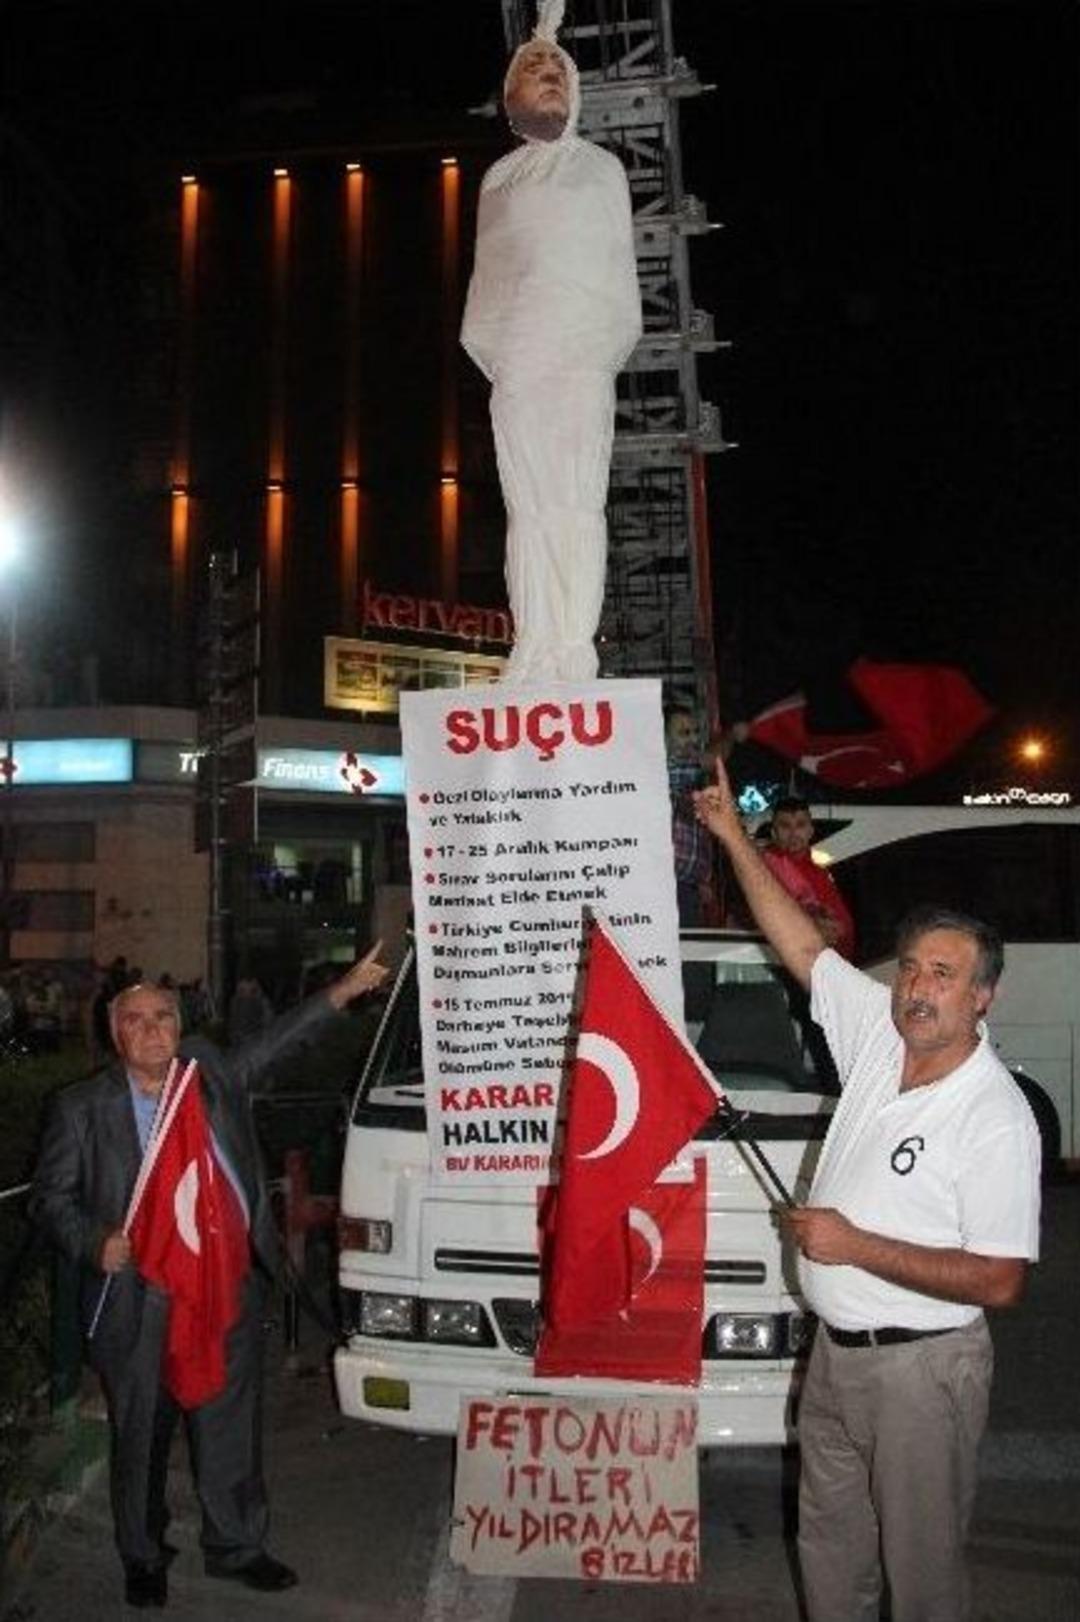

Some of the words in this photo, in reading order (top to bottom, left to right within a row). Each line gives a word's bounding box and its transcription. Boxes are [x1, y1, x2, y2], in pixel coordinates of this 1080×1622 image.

[446, 701, 613, 762] SUÇU
[263, 757, 329, 780] Finans
[429, 816, 448, 827] ve
[464, 996, 532, 1011] Temmuz
[538, 993, 572, 1004] 201
[441, 1083, 554, 1112] KARAR
[444, 1120, 549, 1146] HALKIN
[446, 1157, 470, 1171] BU
[890, 1135, 925, 1175] 6
[466, 1504, 697, 1552] YILDIRAMAZ
